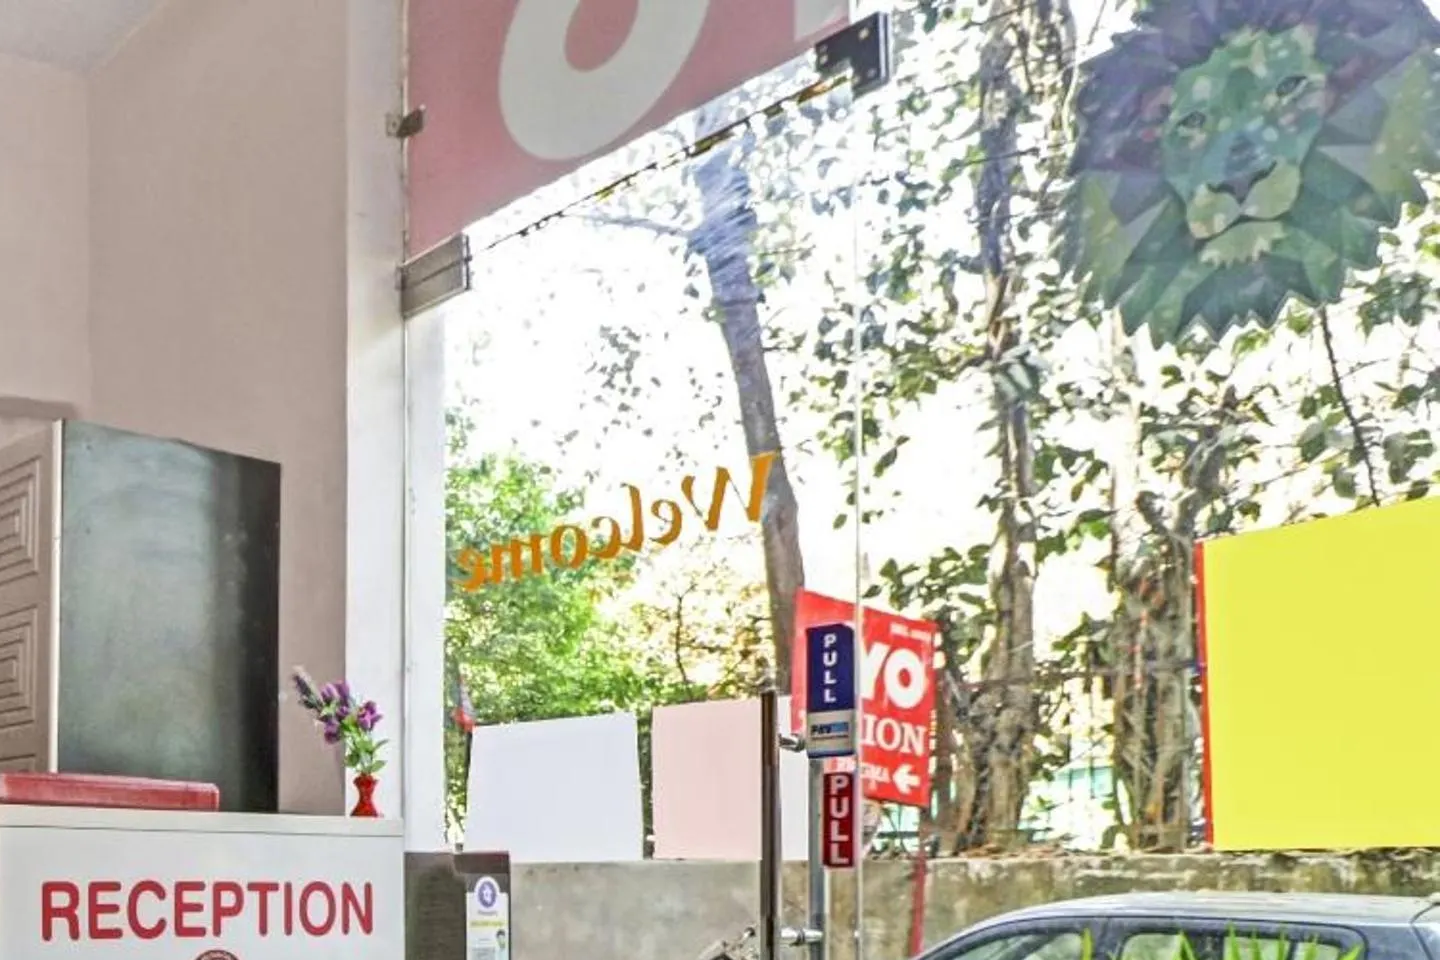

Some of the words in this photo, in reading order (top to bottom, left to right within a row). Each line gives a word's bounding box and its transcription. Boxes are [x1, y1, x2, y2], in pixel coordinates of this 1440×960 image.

[823, 633, 838, 703] PULL
[859, 640, 926, 710] YO
[861, 713, 926, 756] ION
[829, 774, 850, 866] PULL
[40, 880, 375, 942] RECEPTION
